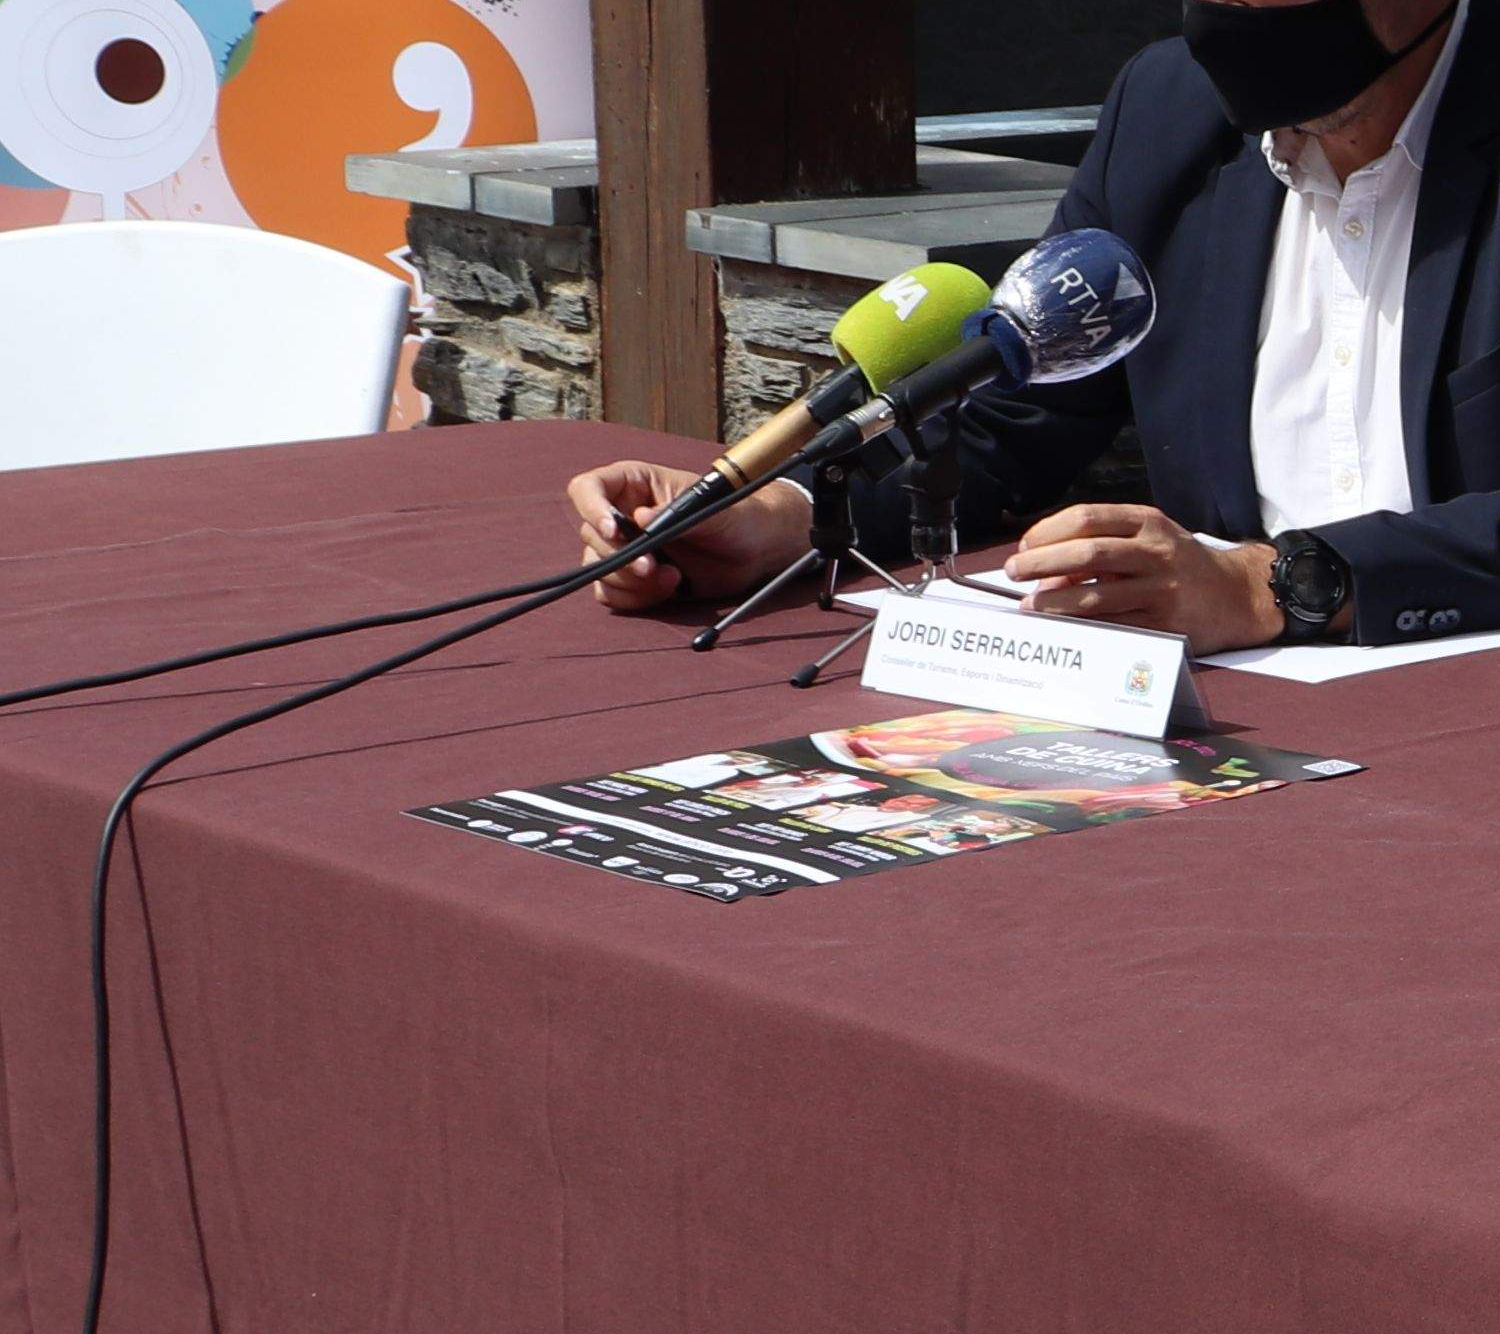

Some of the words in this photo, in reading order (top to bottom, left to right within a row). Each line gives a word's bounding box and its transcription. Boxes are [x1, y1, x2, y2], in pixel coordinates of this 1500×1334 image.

[888, 621, 945, 647] JORDI
[951, 630, 1083, 670] SERRACANTA
[1005, 746, 1052, 760] DE
[1054, 754, 1150, 774] CUINA
[1046, 741, 1180, 768] TALLERS
